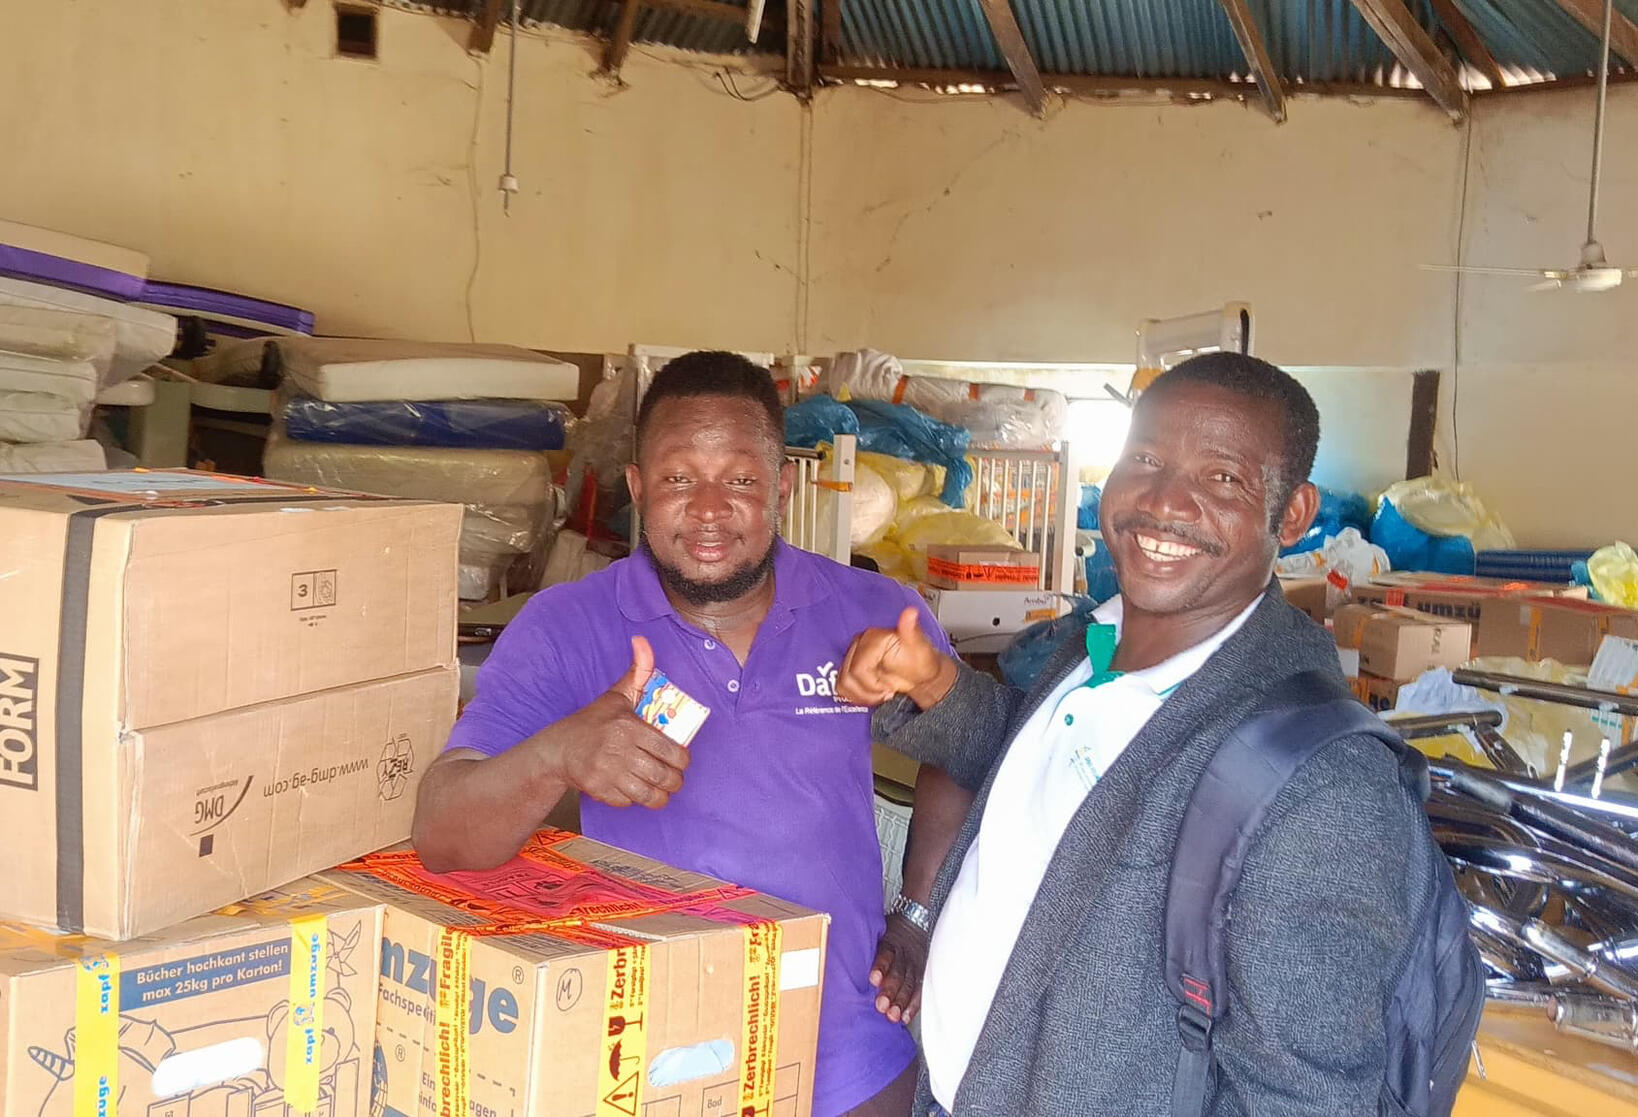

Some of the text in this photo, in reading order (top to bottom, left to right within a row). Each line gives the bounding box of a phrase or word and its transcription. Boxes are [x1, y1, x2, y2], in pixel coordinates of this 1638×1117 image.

[796, 669, 839, 697] Daf
[0, 658, 34, 786] FORM
[263, 758, 369, 798] www.dmg-ag.com
[194, 795, 225, 825] DMG
[137, 943, 289, 985] Bücher hochkant stellen
[142, 959, 283, 1002] max 25kg pro Karton!
[610, 949, 627, 1001] Zerbr
[743, 975, 761, 1091] Zerbrechlich!
[439, 1022, 451, 1117] brechlich!
[96, 1076, 110, 1117] züge
[707, 1095, 723, 1109] Bad
